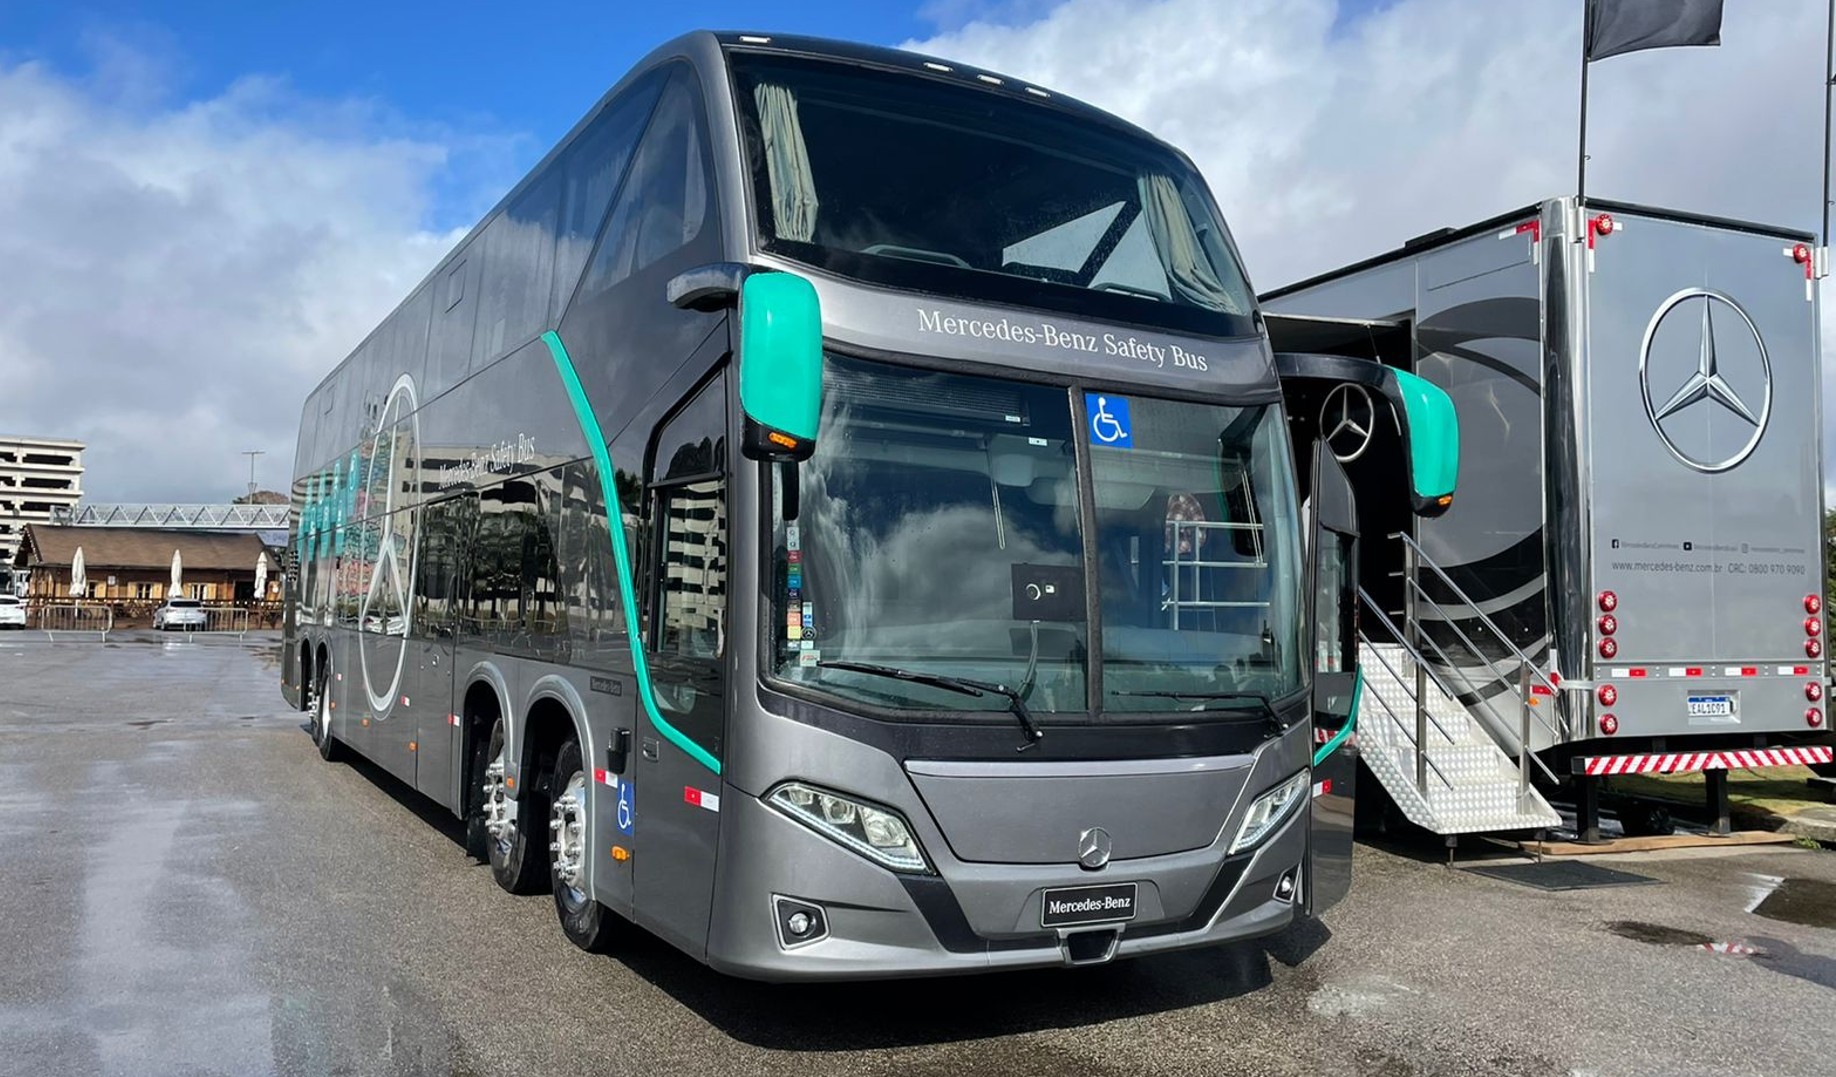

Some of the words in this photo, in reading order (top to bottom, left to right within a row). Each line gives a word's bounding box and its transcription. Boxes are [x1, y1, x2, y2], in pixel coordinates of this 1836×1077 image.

[916, 308, 1099, 352] Mercedes-Benz
[1103, 333, 1166, 368] Safety
[1170, 344, 1209, 372] Bus
[490, 441, 516, 474] Safety
[517, 432, 535, 463] Bus
[1611, 561, 1723, 574] www.mercedes-benz.com.br
[1747, 563, 1769, 574] 0800
[1770, 564, 1785, 575] 970
[1049, 896, 1131, 914] Mercedes-Benz
